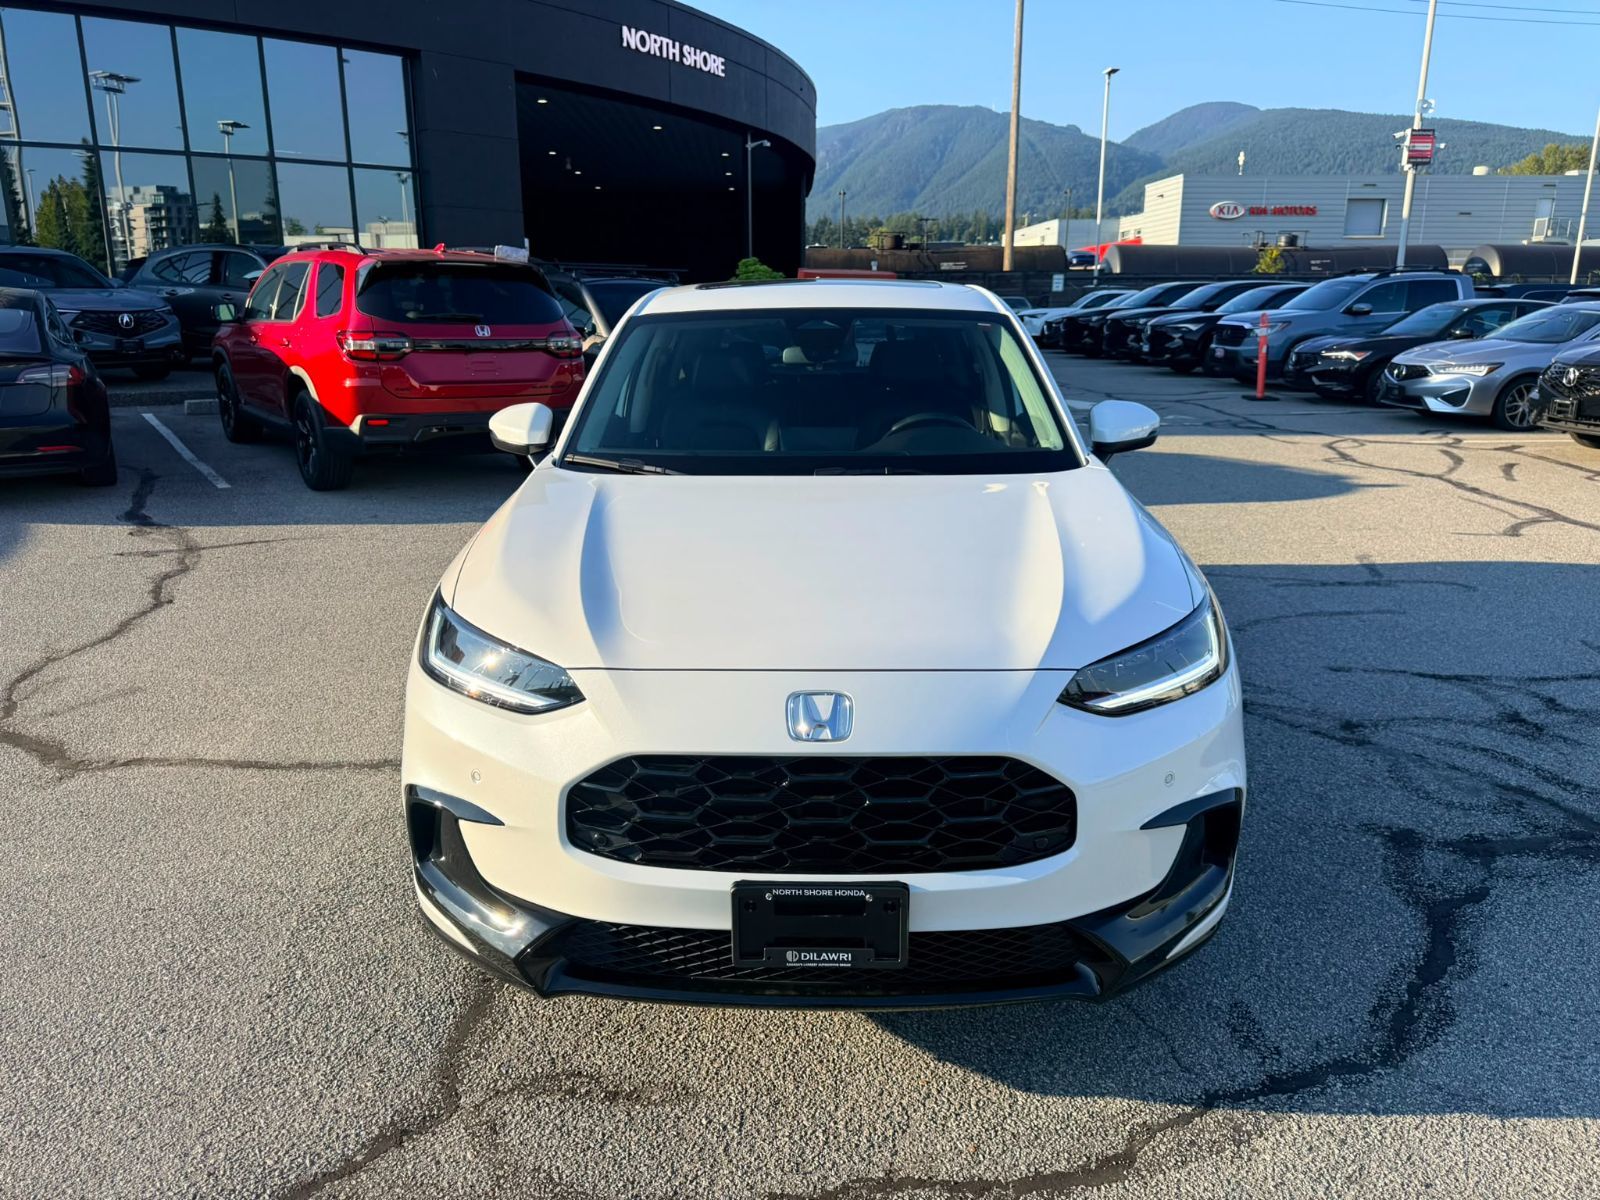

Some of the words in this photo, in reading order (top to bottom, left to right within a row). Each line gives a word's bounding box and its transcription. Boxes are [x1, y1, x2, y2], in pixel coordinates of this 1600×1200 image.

[621, 25, 680, 62] NORTH
[682, 44, 725, 77] SHORE
[1217, 205, 1239, 216] KIA
[834, 889, 866, 897] HONDA
[801, 952, 851, 961] DILAWRI
